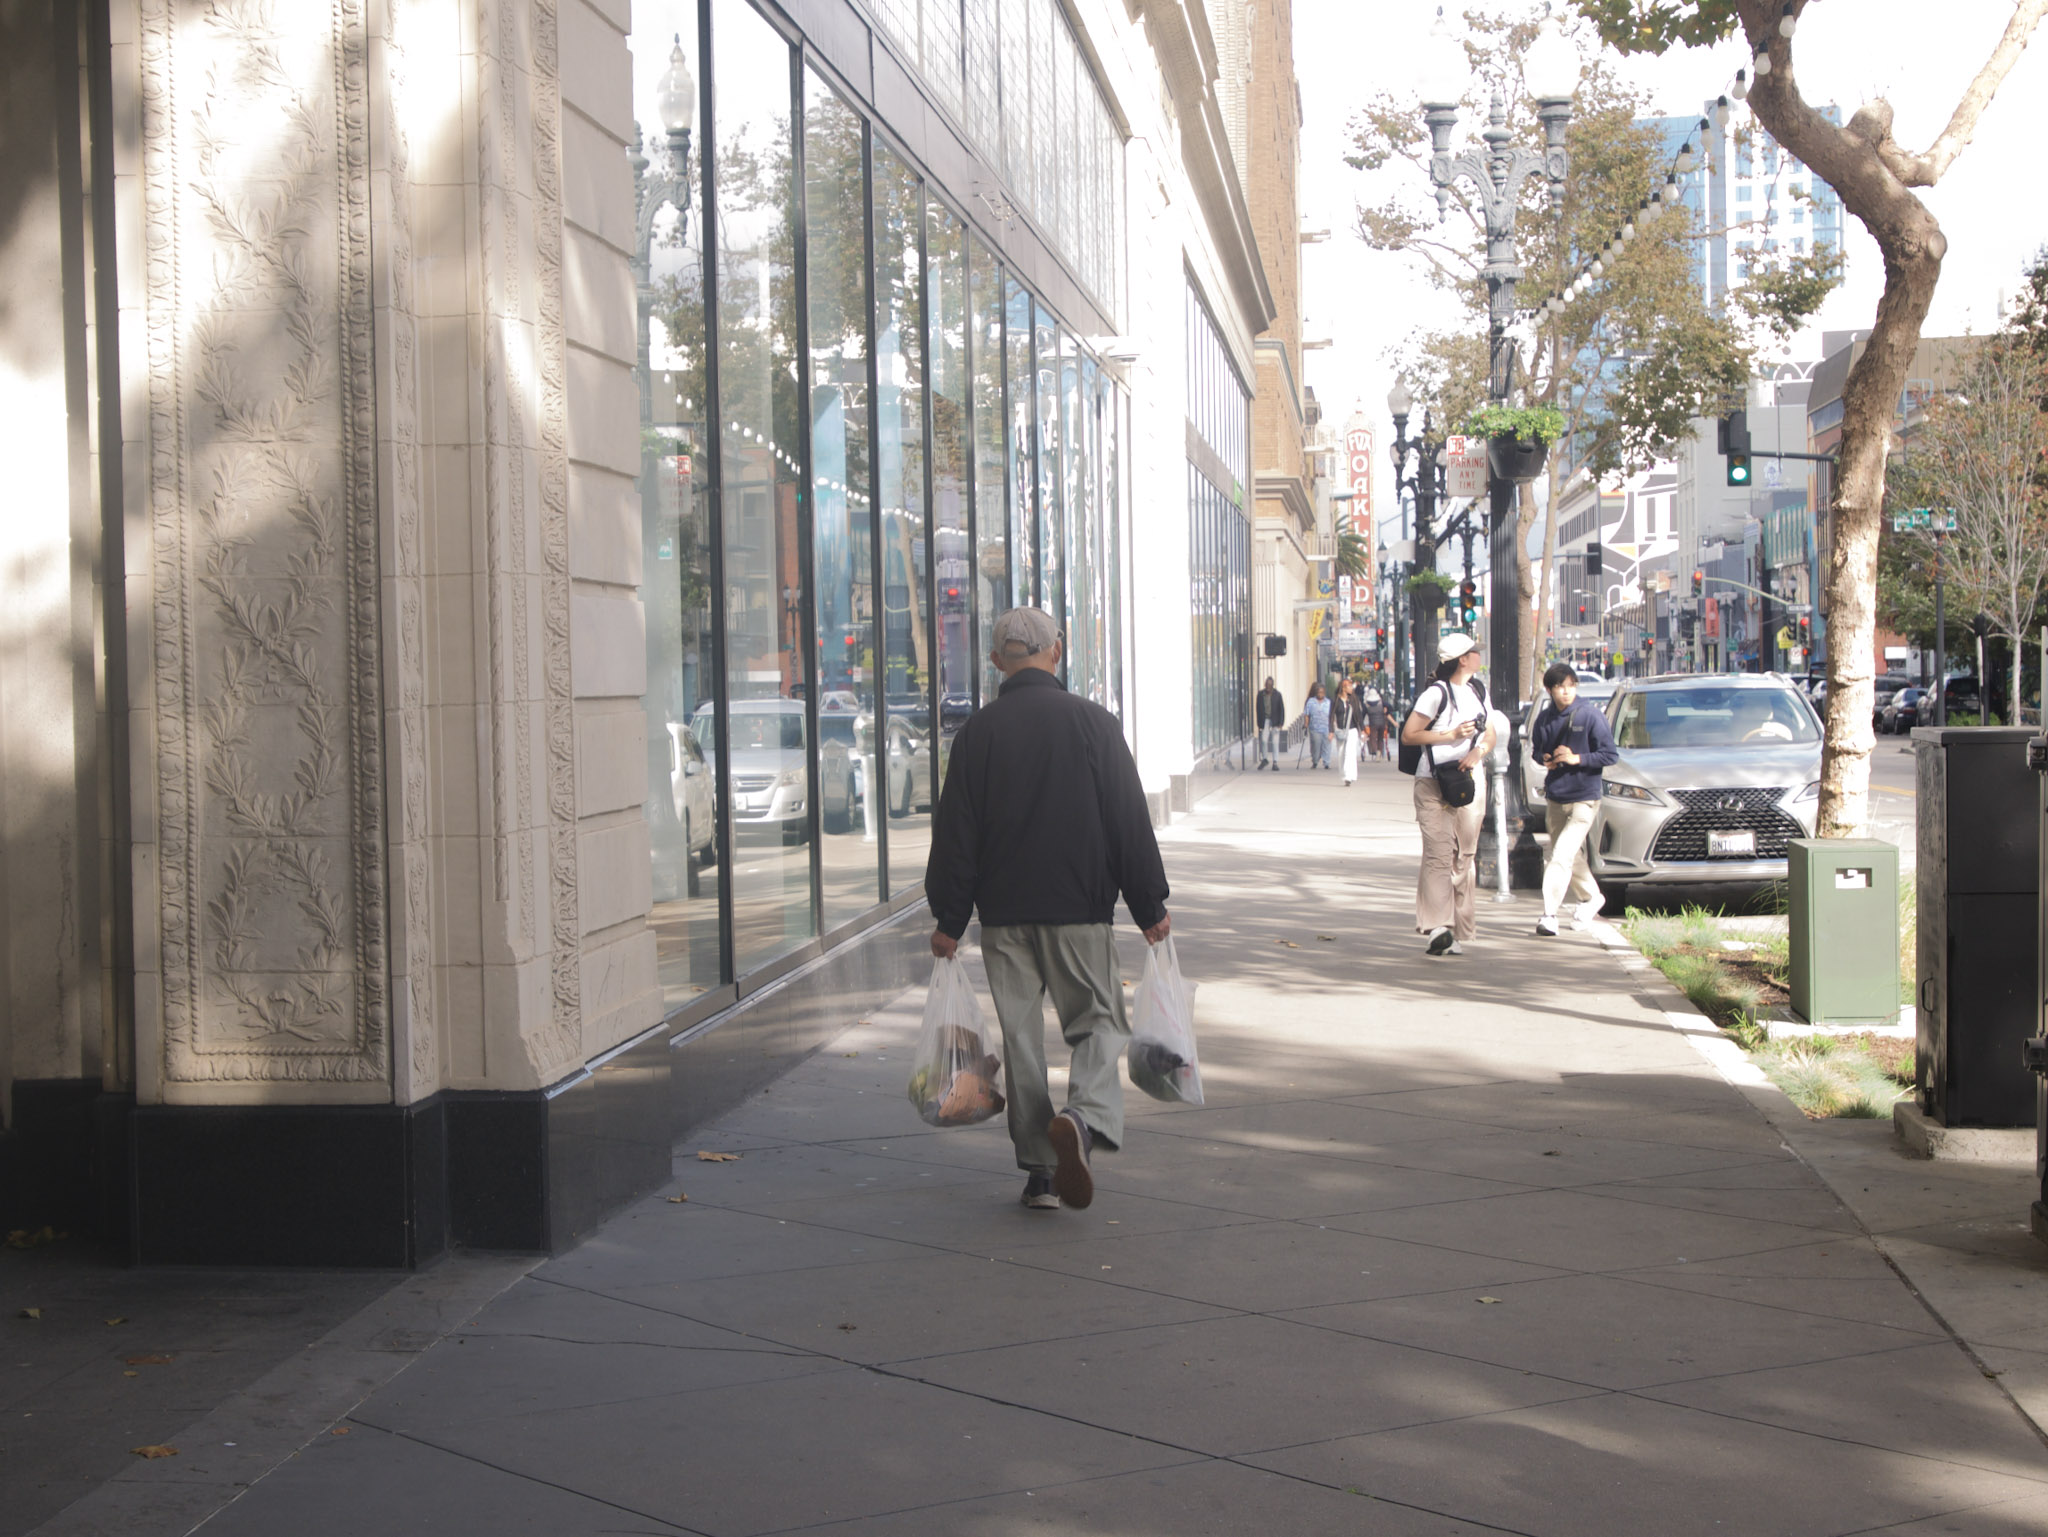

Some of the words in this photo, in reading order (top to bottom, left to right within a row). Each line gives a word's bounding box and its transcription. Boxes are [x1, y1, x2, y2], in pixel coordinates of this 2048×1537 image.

[1347, 432, 1372, 452] FOX
[1450, 457, 1485, 468] PARKING
[1459, 471, 1476, 479] ANY
[1459, 481, 1476, 490] TIME
